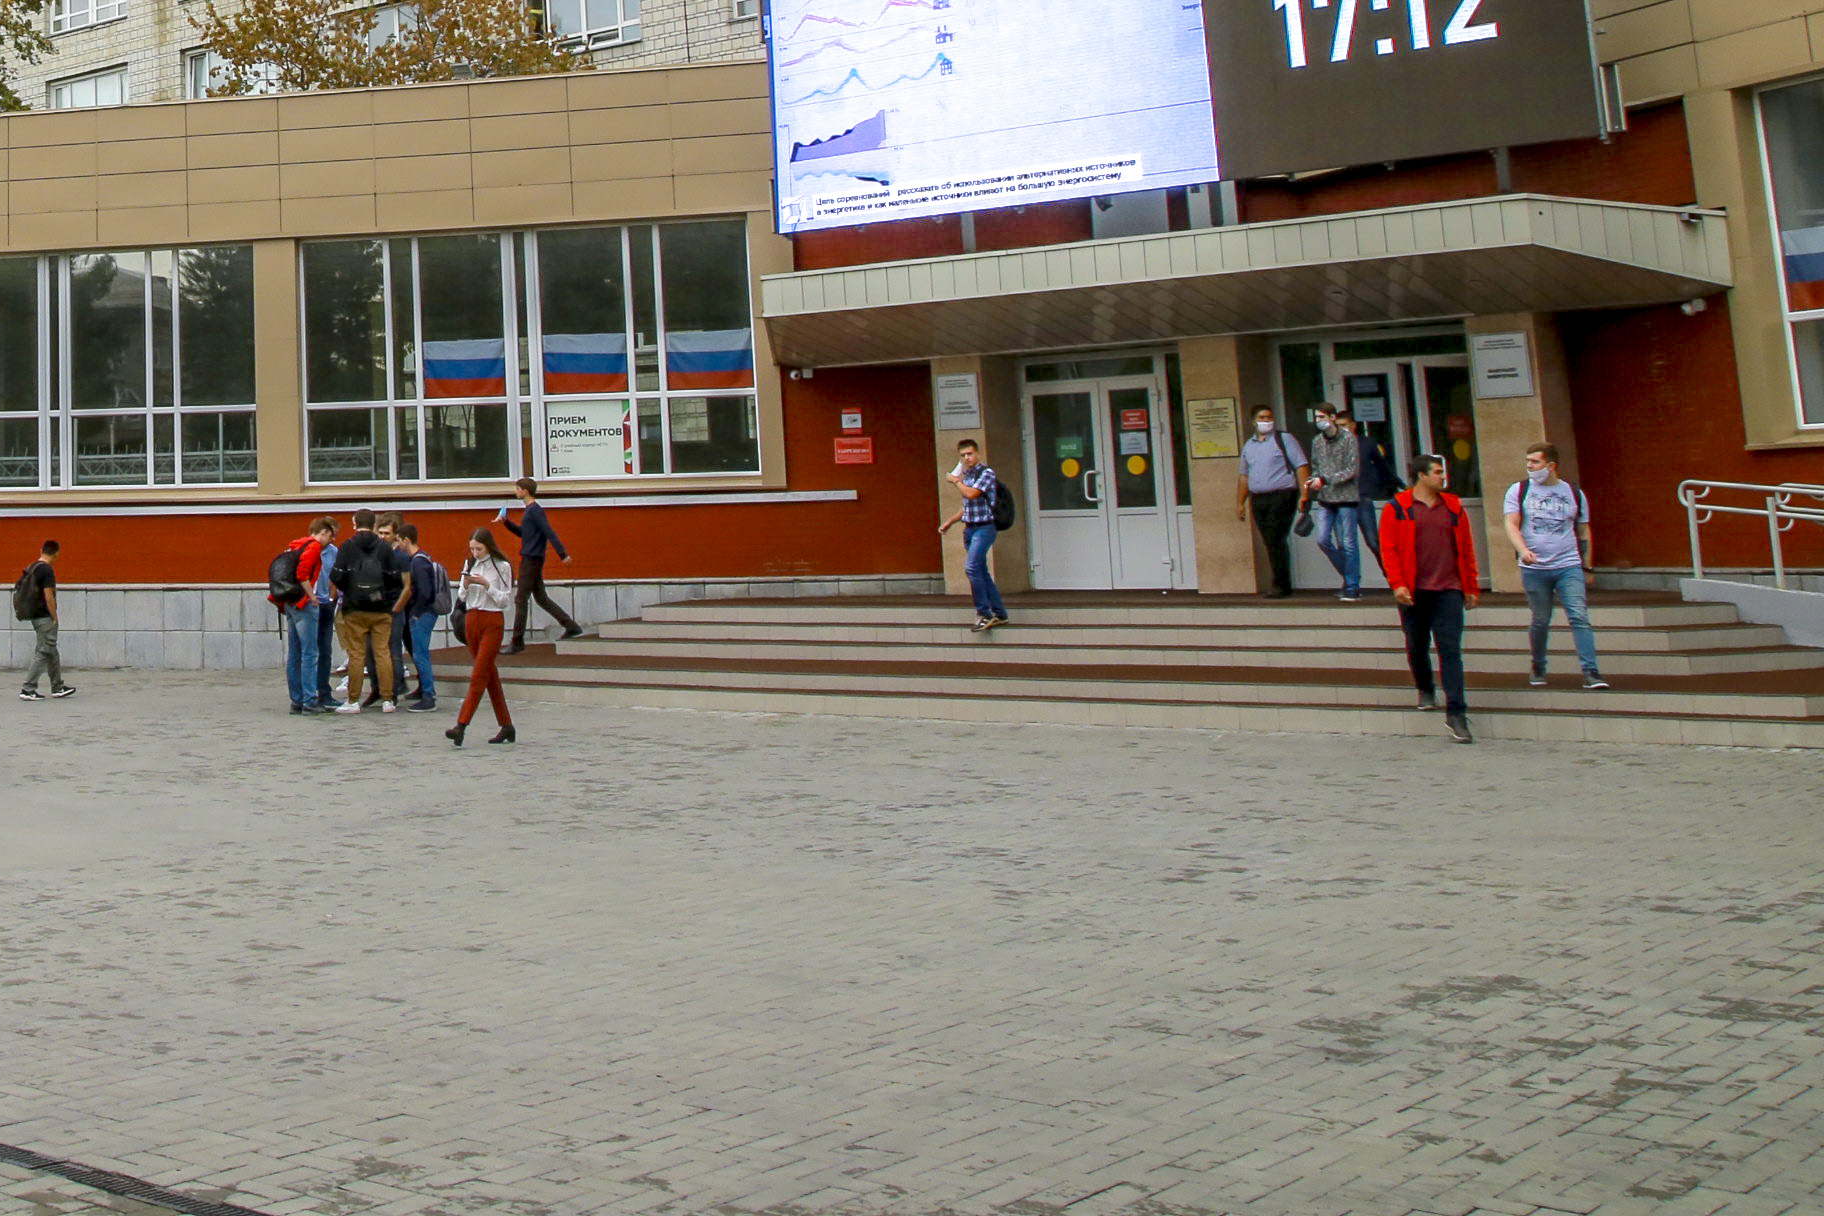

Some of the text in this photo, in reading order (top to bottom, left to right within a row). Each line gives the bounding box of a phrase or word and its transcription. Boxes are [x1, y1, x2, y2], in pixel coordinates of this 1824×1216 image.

[836, 189, 890, 204] соревнований
[897, 185, 939, 196] рассказать
[941, 181, 952, 190] об
[1016, 166, 1084, 181] альтернативных
[1085, 159, 1136, 172] источников
[931, 191, 973, 202] источники
[1017, 178, 1056, 191] большую
[1057, 171, 1122, 186] энергосистему
[549, 416, 587, 425] ПРИЕМ
[549, 427, 623, 439] ДОКУМЕНТОВ
